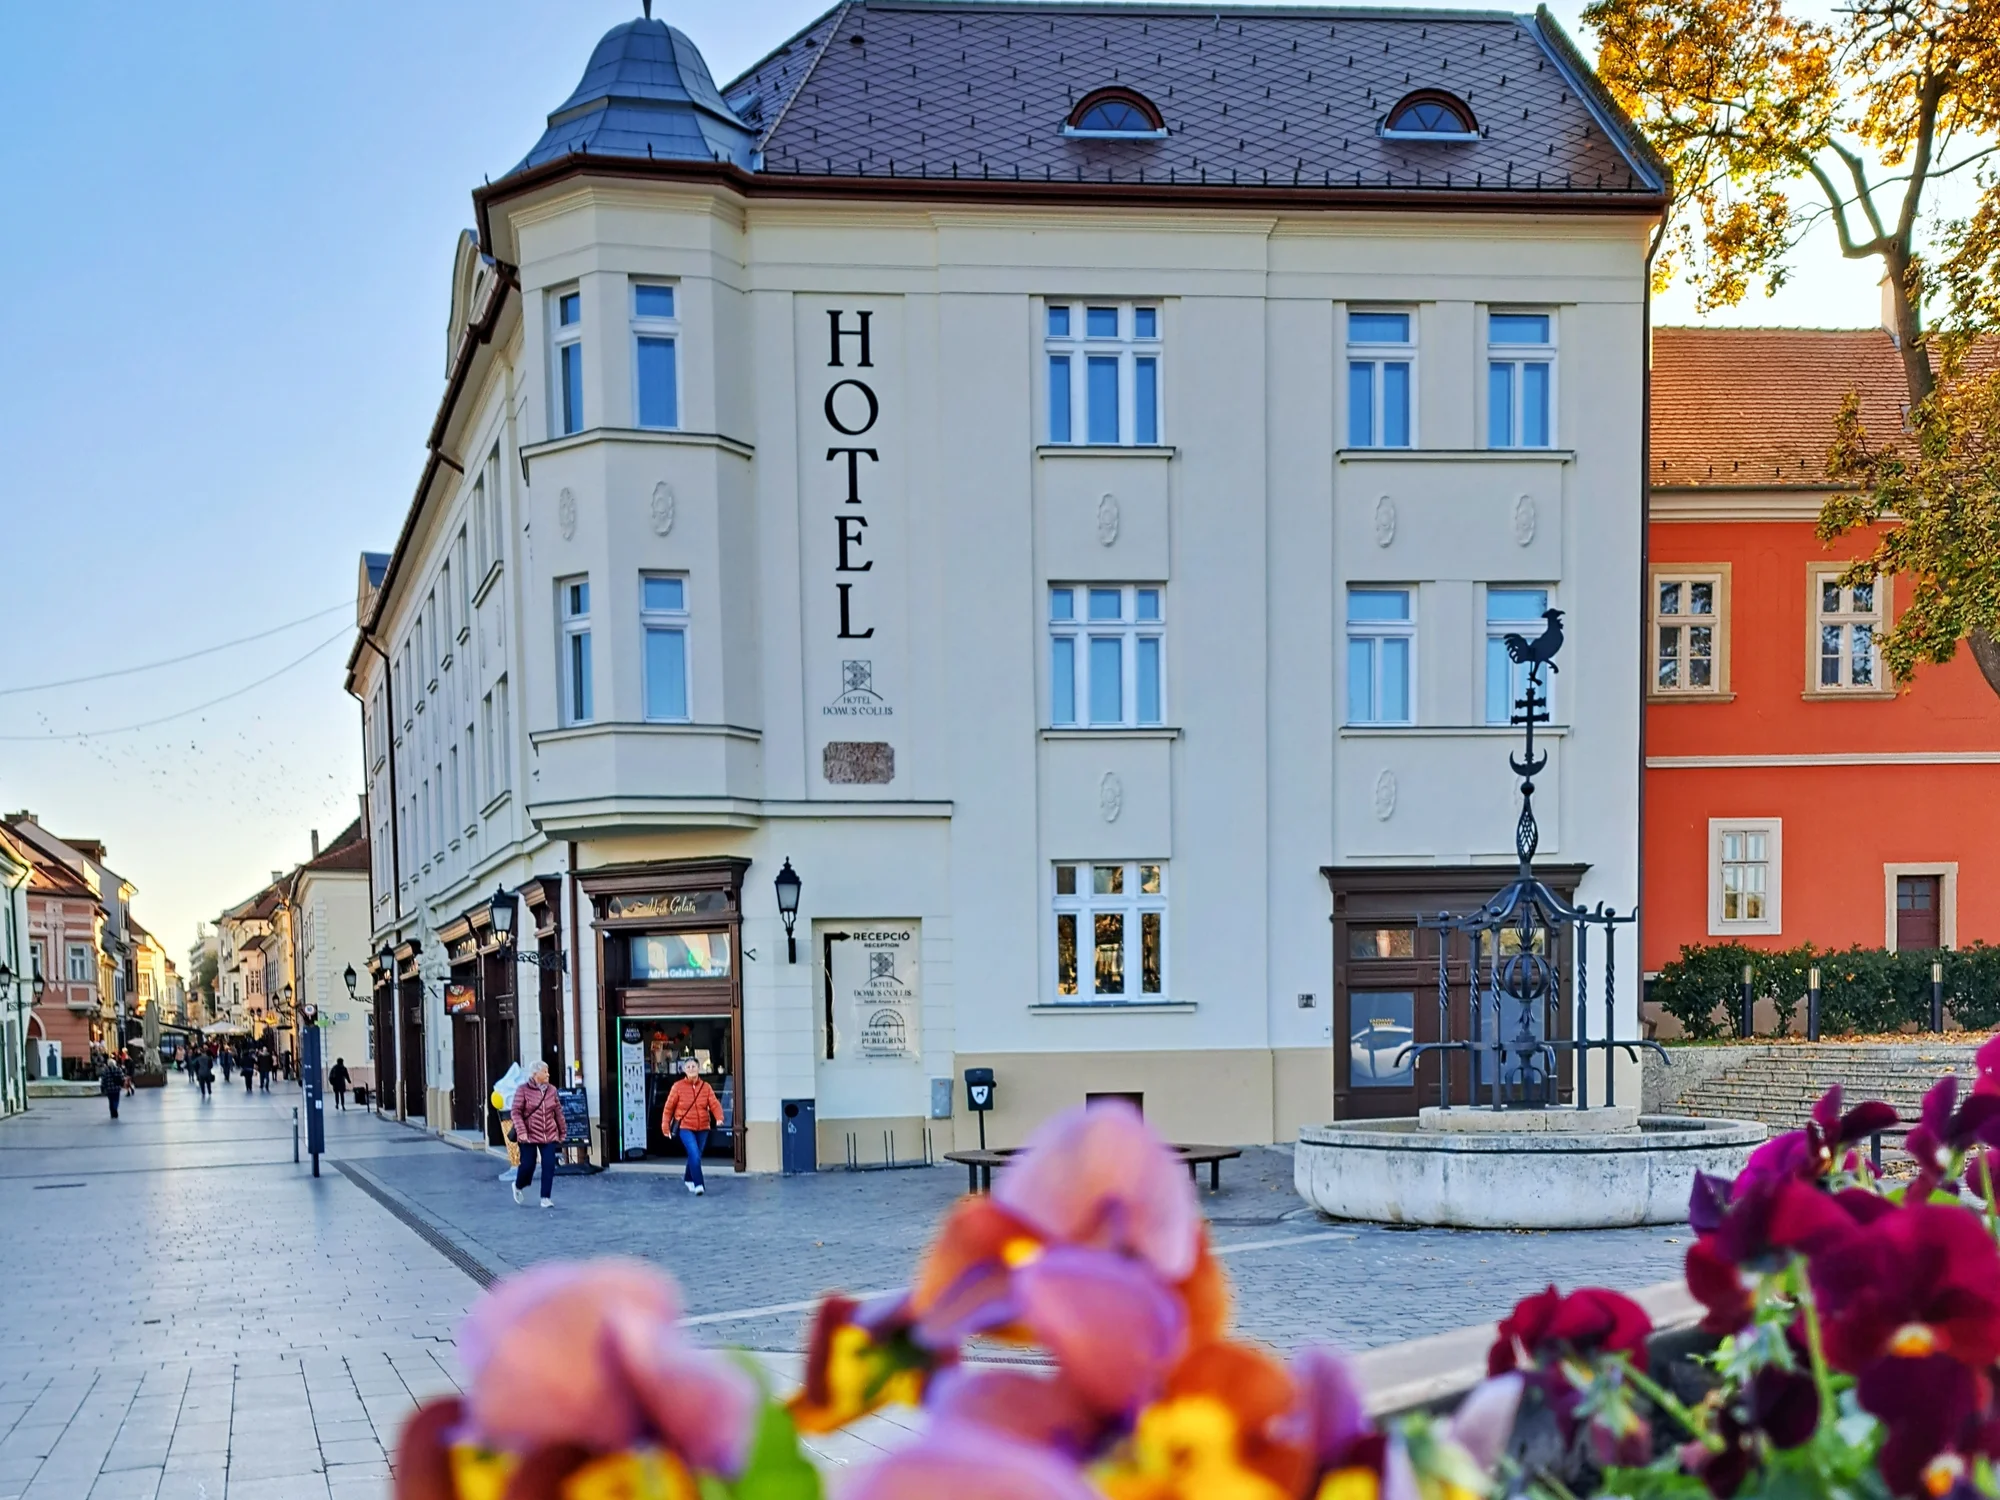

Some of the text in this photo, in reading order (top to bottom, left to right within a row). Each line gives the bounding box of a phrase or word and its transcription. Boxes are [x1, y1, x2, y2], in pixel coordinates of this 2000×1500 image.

[824, 309, 879, 639] HOTEL
[843, 695, 872, 705] HOTEL
[823, 706, 893, 715] DOMUS COLLIS
[670, 896, 697, 915] Gelato
[853, 930, 910, 941] RECEPCIÓ
[648, 969, 668, 979] Adria
[669, 968, 694, 978] Gelato
